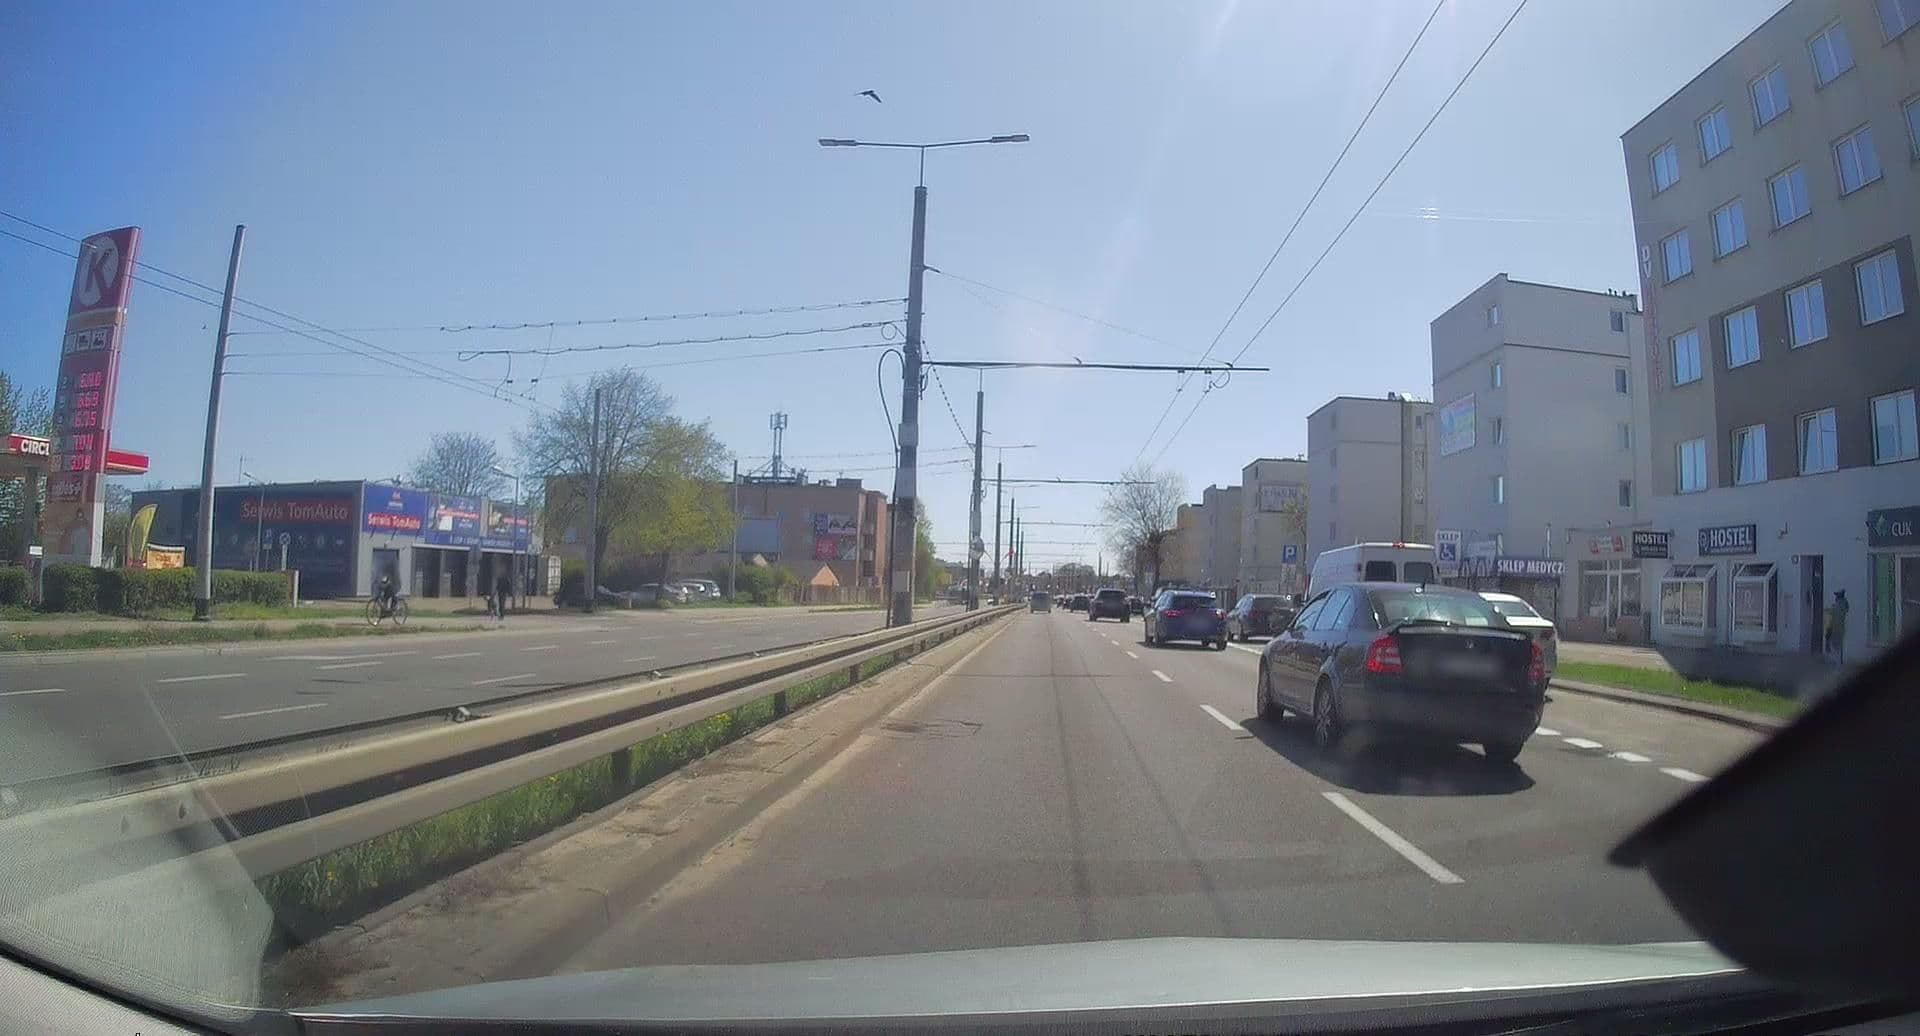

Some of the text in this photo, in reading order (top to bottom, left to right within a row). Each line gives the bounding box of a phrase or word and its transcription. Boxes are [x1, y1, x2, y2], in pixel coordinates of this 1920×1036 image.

[287, 501, 349, 520] TomAuto
[1710, 526, 1752, 548] HOSTEL
[1891, 521, 1913, 537] CUK
[1635, 533, 1667, 544] HOSTEL
[1497, 559, 1565, 575] SKLEP MEDYCZ
